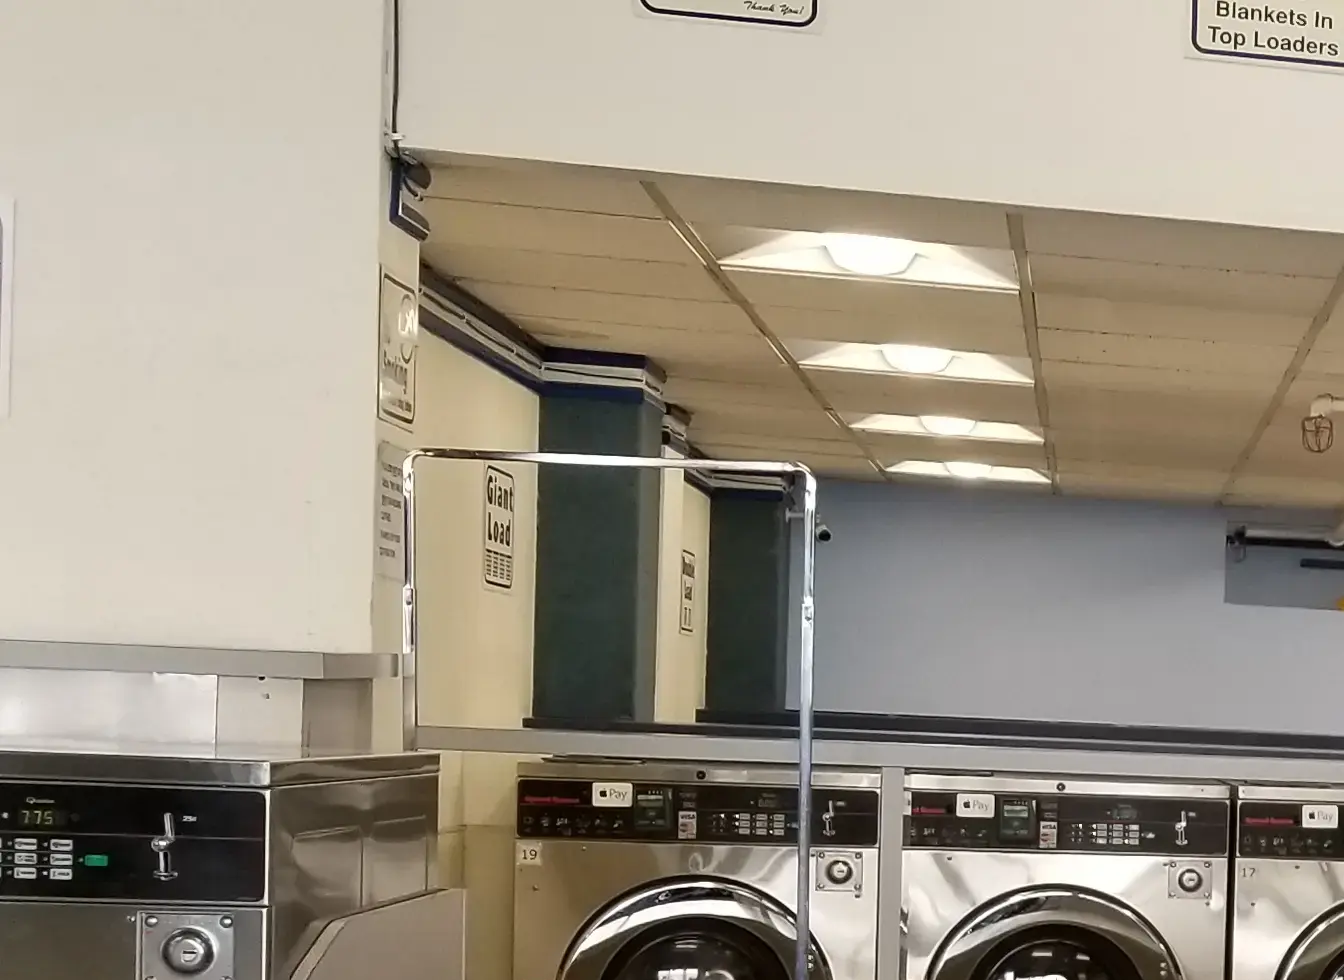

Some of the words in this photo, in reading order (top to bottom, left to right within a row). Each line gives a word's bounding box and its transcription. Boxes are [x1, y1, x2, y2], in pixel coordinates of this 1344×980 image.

[744, 0, 775, 13] Thank
[779, 4, 805, 16] You!
[1216, 0, 1307, 27] Blankets
[1314, 11, 1333, 30] In
[1207, 25, 1246, 50] Top
[1253, 30, 1339, 57] Loaders
[487, 474, 513, 512] Giant
[488, 511, 511, 547] Load
[609, 788, 628, 800] Pay
[972, 800, 990, 812] Pay
[1317, 812, 1333, 822] Pay
[521, 849, 538, 861] 19
[1241, 867, 1256, 878] 17
